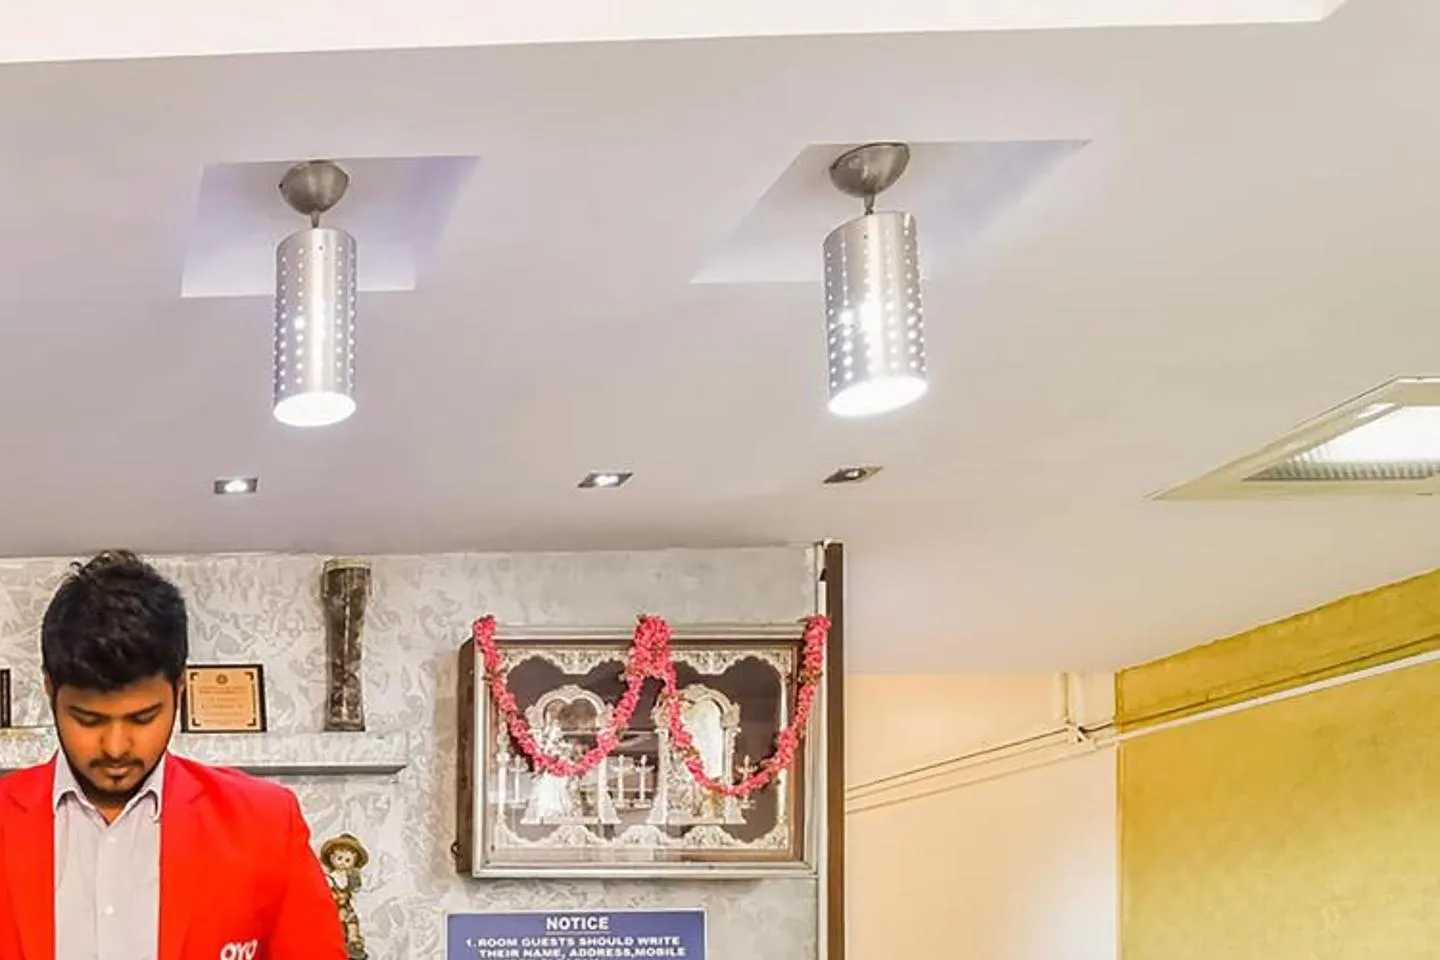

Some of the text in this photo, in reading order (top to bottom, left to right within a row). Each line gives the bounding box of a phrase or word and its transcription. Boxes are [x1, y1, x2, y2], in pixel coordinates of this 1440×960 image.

[546, 916, 610, 931] NOTICE
[478, 938, 518, 948] ROOM
[521, 937, 575, 947] GUESTS
[579, 936, 634, 947] SHOULD
[637, 936, 680, 945] WRITE
[479, 949, 519, 957] THEIR
[523, 949, 566, 959] NAME,
